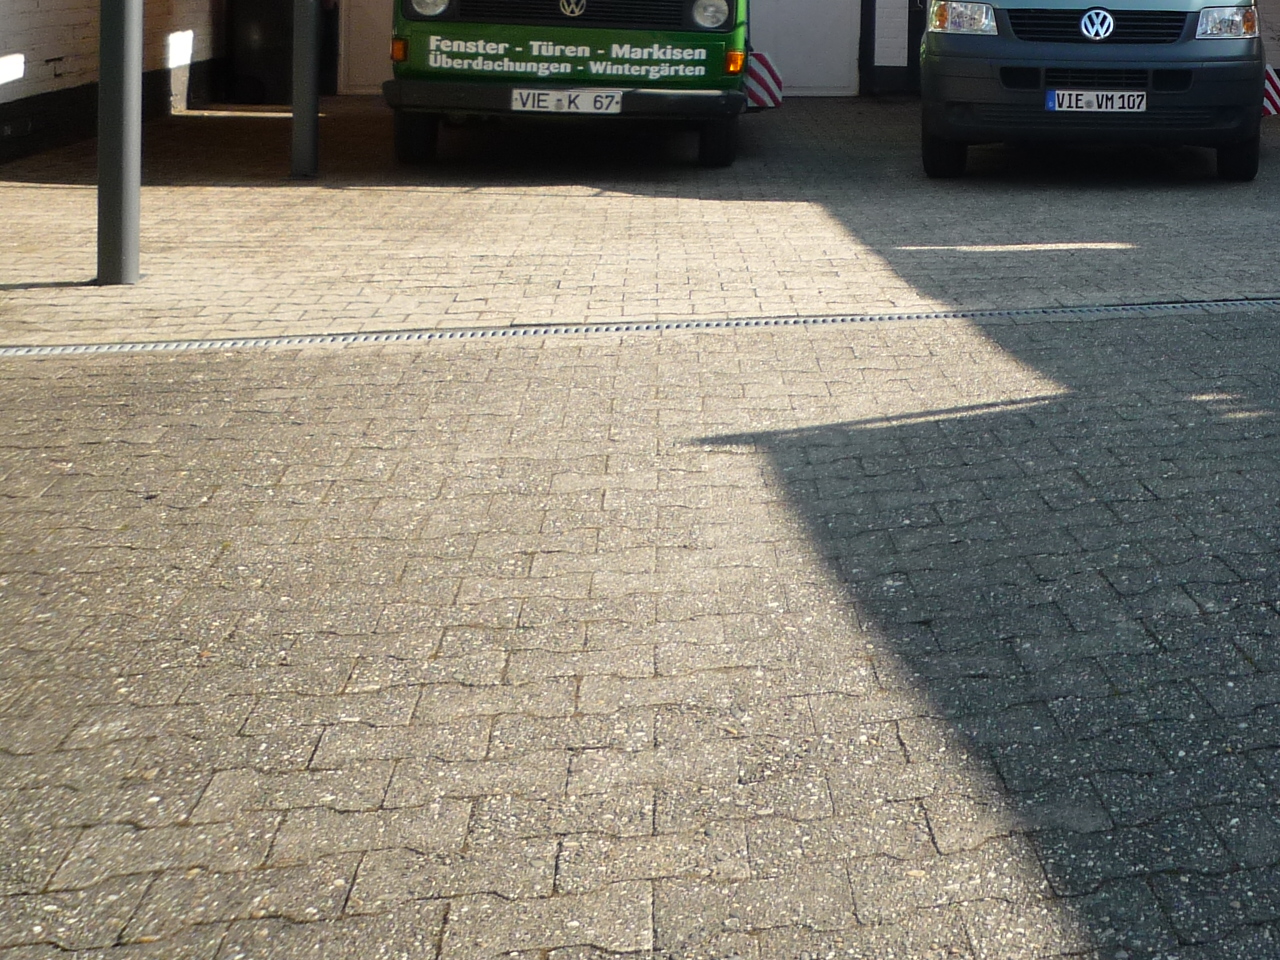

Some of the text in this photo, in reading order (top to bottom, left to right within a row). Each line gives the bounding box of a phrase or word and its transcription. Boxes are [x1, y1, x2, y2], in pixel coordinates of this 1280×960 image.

[428, 35, 509, 55] Fenster
[530, 40, 590, 58] Türen
[611, 43, 707, 60] Markisen
[428, 51, 571, 76] Überdachungen
[589, 60, 706, 80] Wintergärten
[519, 92, 550, 109] VIE
[568, 94, 580, 110] K
[594, 95, 616, 111] 67
[1056, 93, 1084, 109] VIE
[1096, 94, 1114, 109] VM
[1118, 94, 1145, 110] 107
